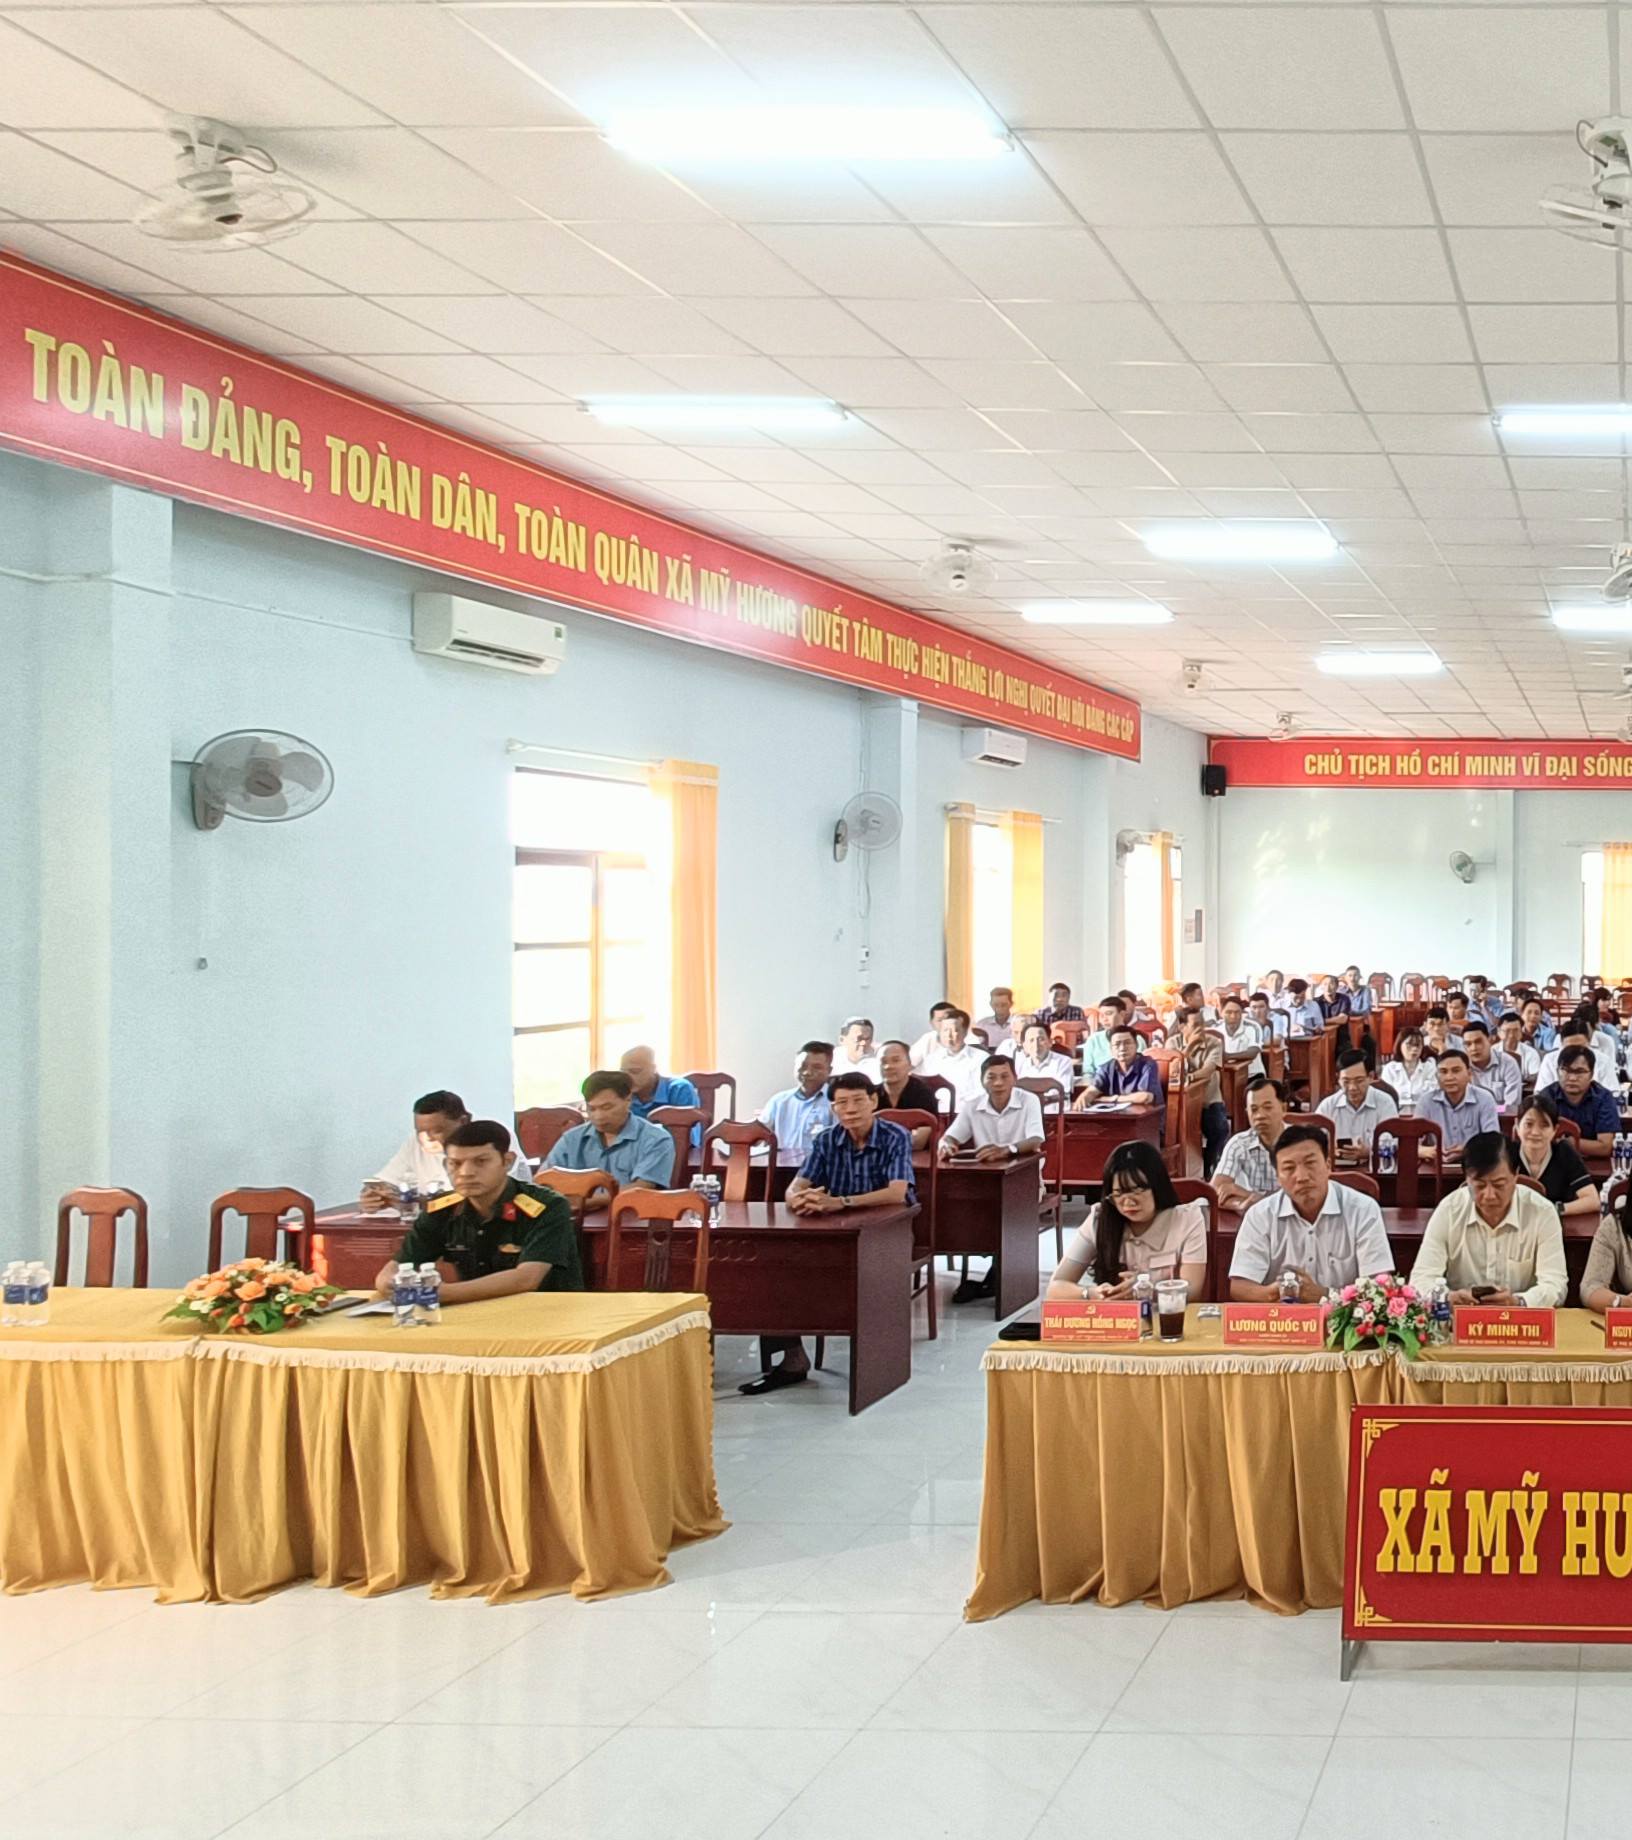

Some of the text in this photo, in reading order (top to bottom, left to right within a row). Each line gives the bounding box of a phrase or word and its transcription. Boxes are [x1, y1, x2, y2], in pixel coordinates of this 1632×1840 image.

[24, 328, 166, 439] TOÀN
[179, 375, 313, 492] ĐẢNG,
[325, 434, 421, 520] TOÀN
[431, 471, 506, 553] DÂN,
[514, 503, 587, 573] TOÀN
[594, 533, 660, 596] QUÂN
[665, 553, 695, 607] XÃ
[700, 566, 731, 617] MỸ
[736, 580, 798, 638] HƯƠNG
[802, 603, 850, 654] QUYẾT
[852, 617, 884, 664] TÂM
[886, 632, 920, 680] THỰC
[921, 643, 951, 689] HIỆN
[951, 650, 988, 698] THẮNG
[988, 669, 1005, 708] LỢI
[1005, 674, 1029, 716] NGHỊ
[1029, 682, 1057, 719] QUYẾT
[1056, 693, 1071, 728] ĐẠI
[1304, 748, 1342, 776] CHỦ
[1347, 755, 1391, 780] TỊCH
[1396, 748, 1422, 776] HỒ
[1427, 749, 1460, 777] CHÍ
[1465, 754, 1517, 777] MINH
[1521, 752, 1542, 777] VĨ
[1545, 754, 1579, 781] ĐẠI
[1229, 1319, 1267, 1332] LƯƠNG
[1269, 1317, 1300, 1333] QUỐC
[1487, 1324, 1519, 1337] MINH
[1521, 1324, 1540, 1337] THI
[1375, 1467, 1456, 1574] XÃ
[1463, 1470, 1549, 1576] MỸ
